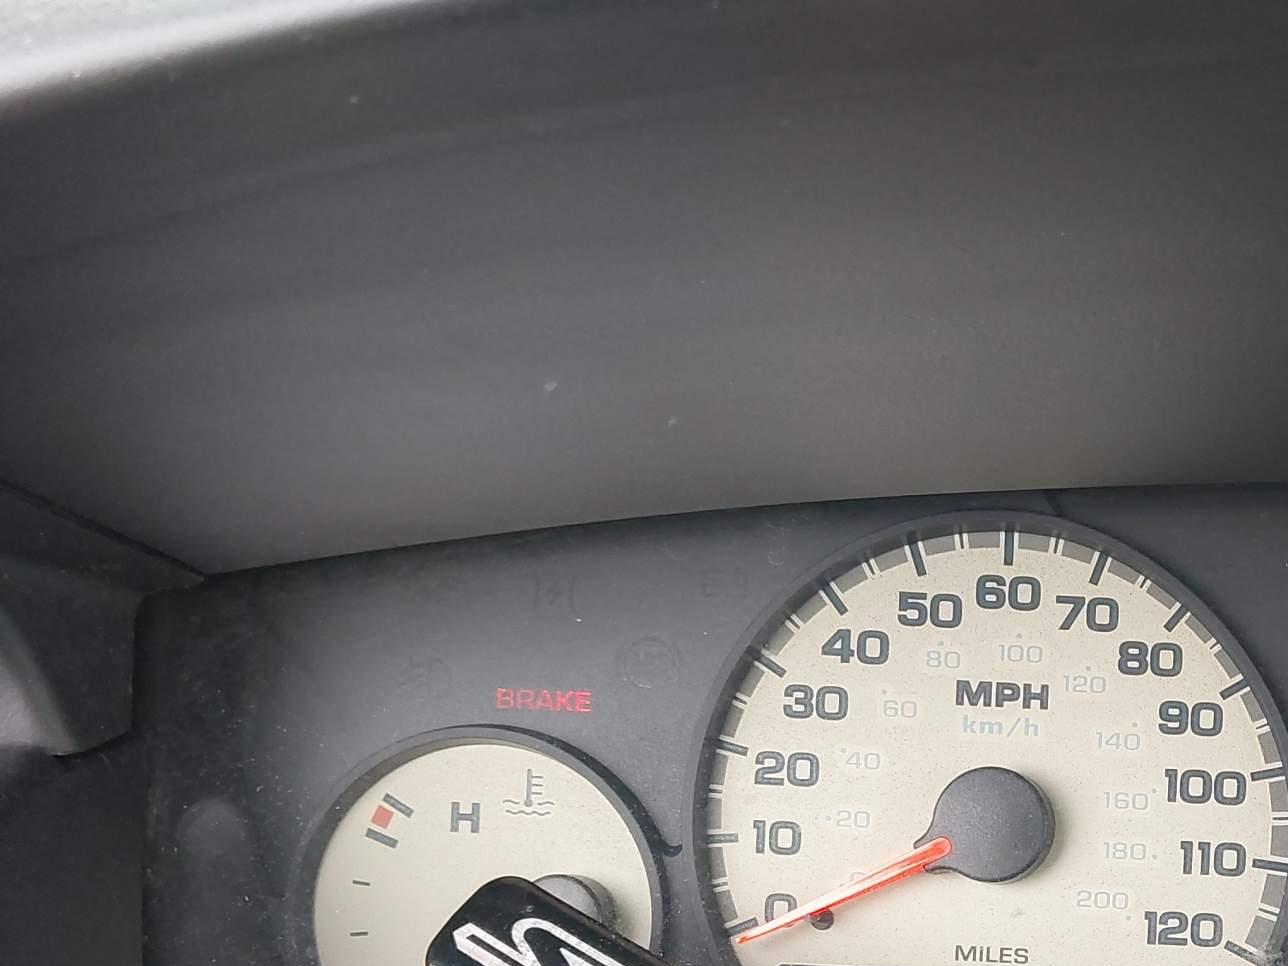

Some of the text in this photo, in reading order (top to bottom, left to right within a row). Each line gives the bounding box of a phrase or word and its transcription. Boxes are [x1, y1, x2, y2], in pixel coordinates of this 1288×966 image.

[976, 576, 1041, 611] 60
[898, 592, 963, 628] 50
[1056, 595, 1120, 632] 70
[822, 629, 890, 665] 40
[926, 651, 960, 669] 80
[999, 644, 1043, 663] 100
[1119, 641, 1183, 676] 80
[496, 688, 592, 712] BRAKE
[956, 681, 1049, 710] MPH
[1064, 675, 1107, 694] 120
[784, 686, 848, 720] 30
[883, 700, 917, 718] 60
[1158, 702, 1223, 736] 90
[962, 717, 1040, 736] km/h
[1096, 733, 1140, 751] 140
[755, 752, 819, 786] 20
[846, 752, 880, 770] 40
[1105, 792, 1148, 810] 160
[1166, 769, 1247, 805] 100
[450, 801, 480, 833] H
[836, 810, 871, 828] 20
[753, 821, 801, 855] 10
[1105, 842, 1146, 860] 180
[1180, 841, 1246, 876] 110
[765, 894, 798, 928] 0
[1076, 891, 1129, 909] 200
[1145, 912, 1223, 947] 120
